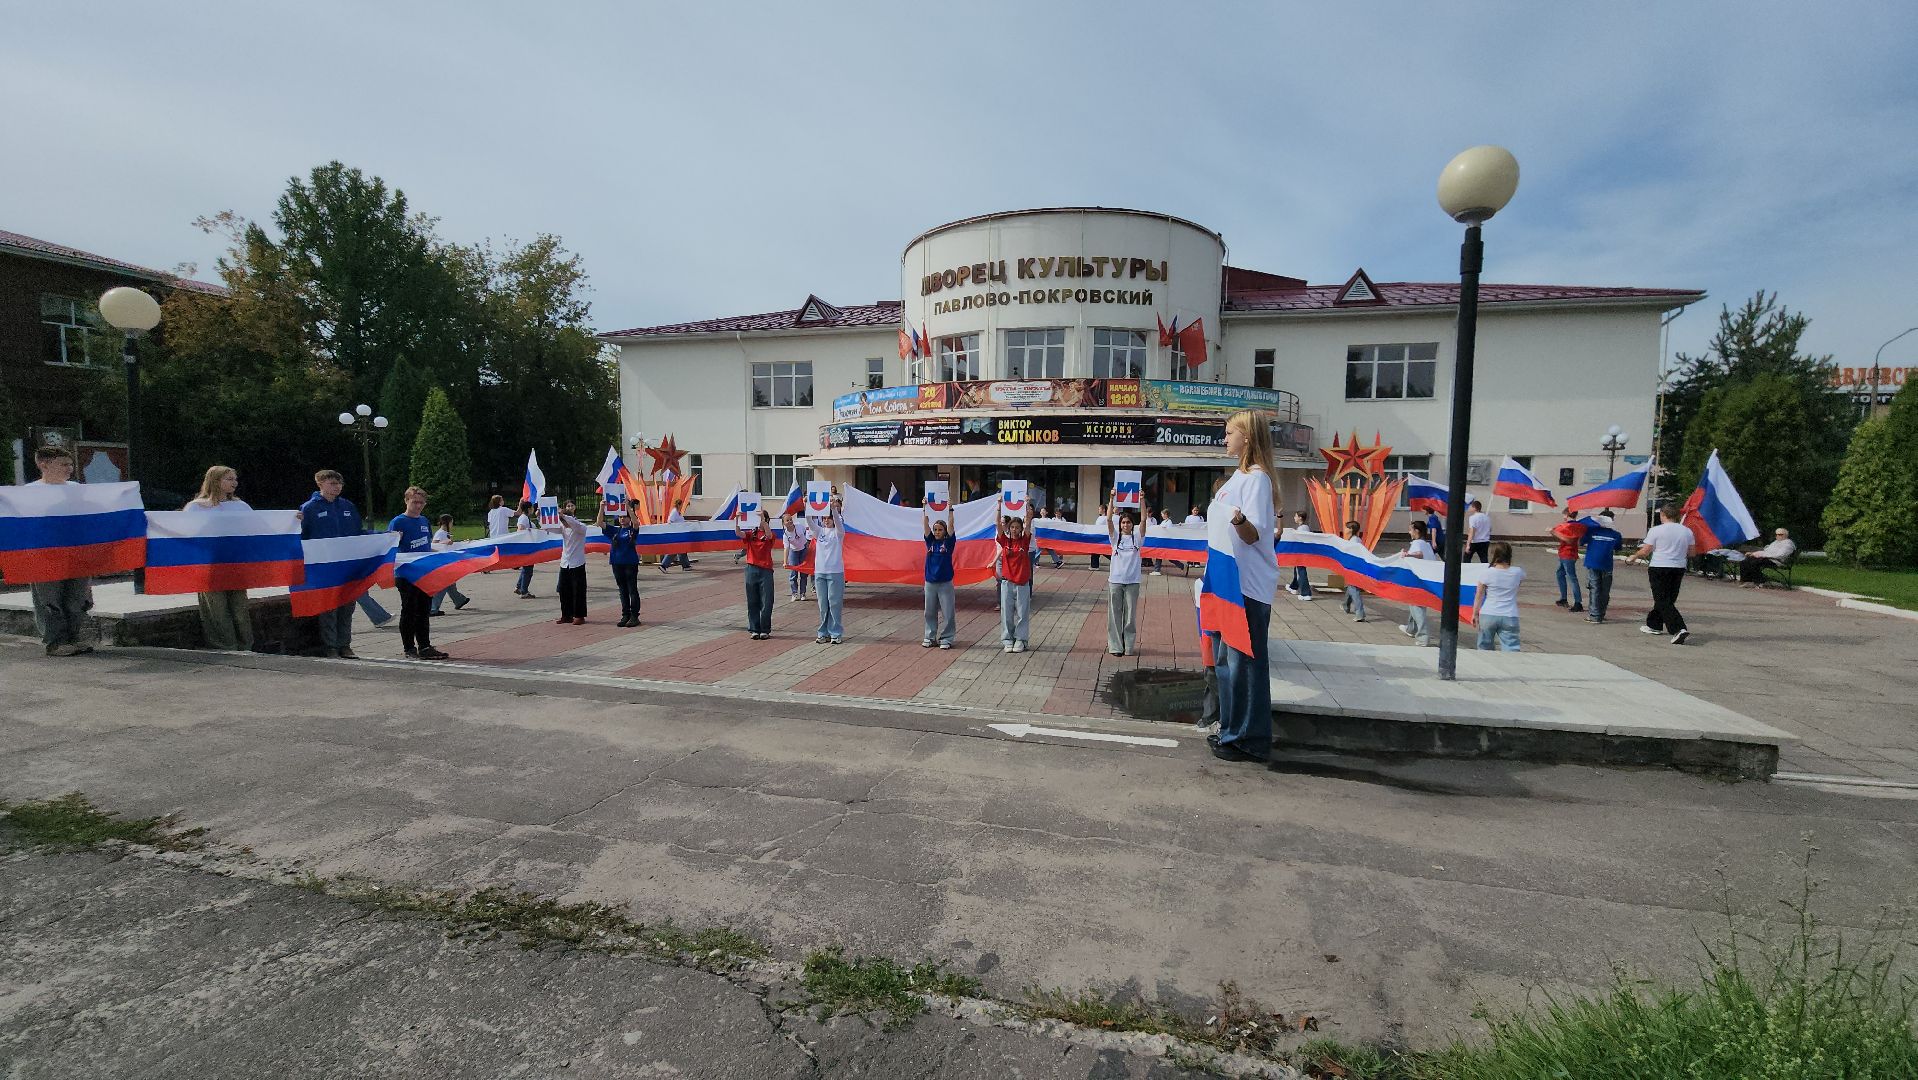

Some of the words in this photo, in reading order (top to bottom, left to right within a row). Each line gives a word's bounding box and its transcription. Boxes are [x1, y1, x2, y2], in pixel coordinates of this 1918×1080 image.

[921, 259, 1008, 296] ДВОРЕЦ
[1017, 256, 1168, 282] КУЛЬТУРЫ
[934, 288, 1153, 315] ПАВЛОВО-ПОКРОВСКИЙ
[1109, 384, 1138, 392] НАЧАЛО
[1110, 393, 1137, 405] 12:00
[904, 425, 914, 437] 17
[998, 419, 1032, 430] ВИКТОР
[1086, 424, 1132, 434] ИСТОРИЯ
[997, 429, 1060, 443] САЛТЫКОВ
[1156, 426, 1172, 443] 26
[1173, 433, 1212, 445] ОКТЯБРЯ
[1116, 481, 1140, 503] И
[605, 492, 626, 511] Ы
[541, 505, 559, 524] М
